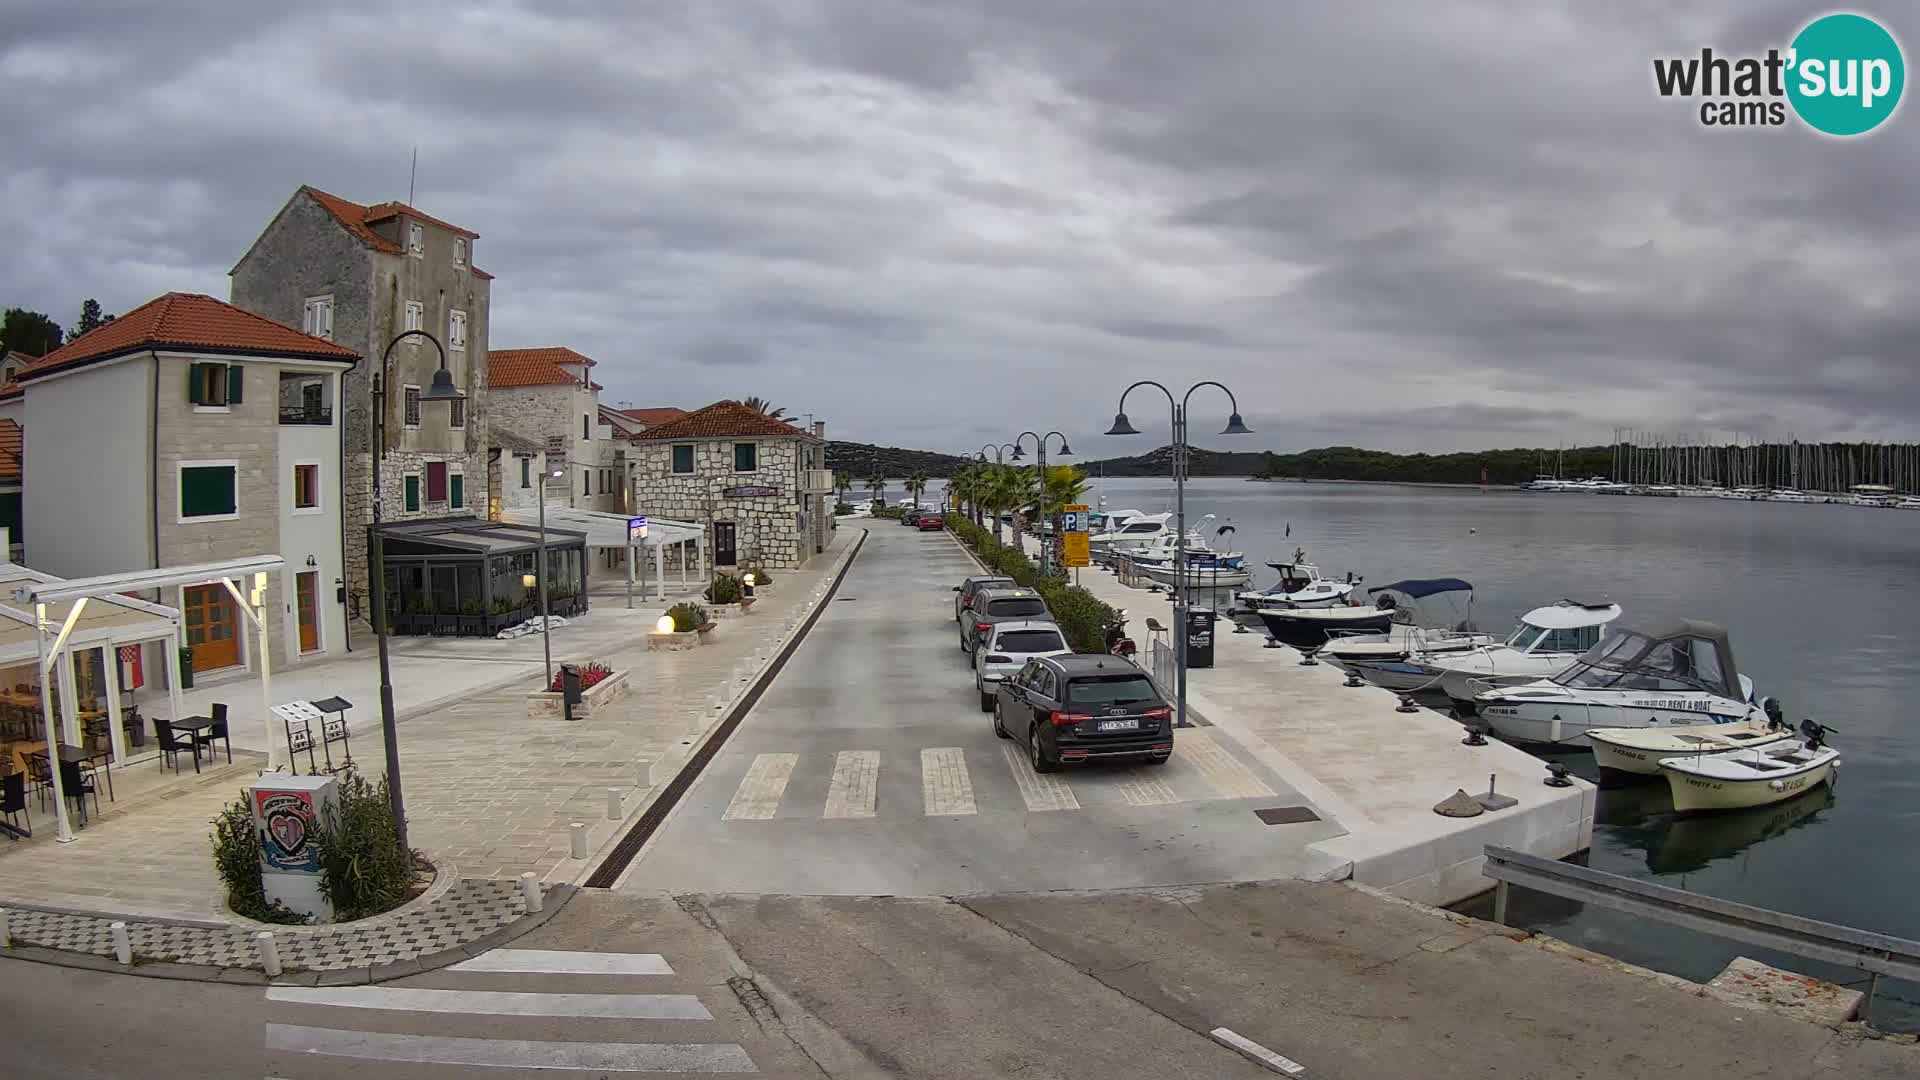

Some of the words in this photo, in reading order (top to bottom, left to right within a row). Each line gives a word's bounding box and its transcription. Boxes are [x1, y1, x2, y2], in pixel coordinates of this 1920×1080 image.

[1667, 700, 1686, 709] RENT
[1687, 701, 1693, 710] A
[1694, 701, 1712, 712] BOAT
